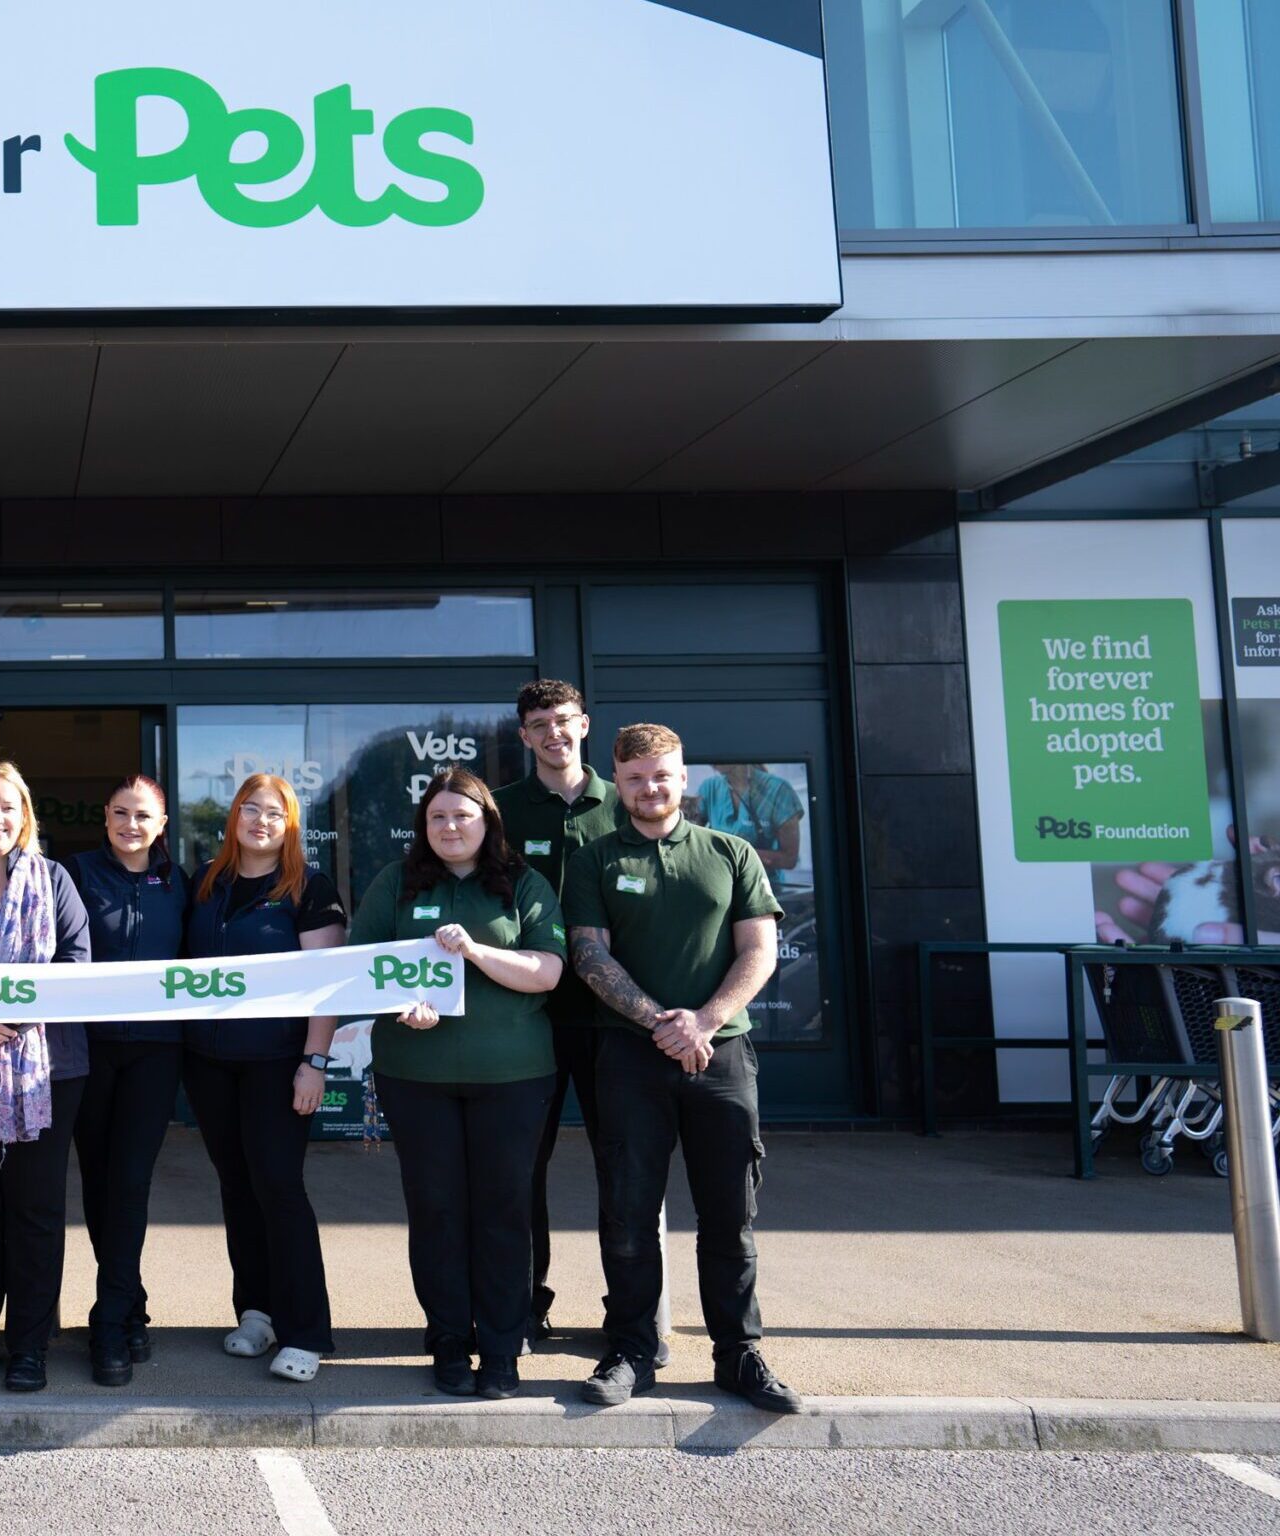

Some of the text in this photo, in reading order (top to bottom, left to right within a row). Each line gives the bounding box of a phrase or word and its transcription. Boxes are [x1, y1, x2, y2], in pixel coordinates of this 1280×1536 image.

[63, 67, 485, 229] Pets
[1243, 619, 1270, 629] Pets
[1256, 631, 1275, 643] for
[1041, 635, 1151, 660] We find
[1046, 666, 1154, 691] forever
[1029, 696, 1175, 722] homes for
[406, 731, 477, 761] Vets
[1046, 727, 1164, 759] adopted
[1073, 761, 1142, 790] pets.
[1036, 816, 1190, 839] Pets Foundation
[160, 966, 247, 999] Pets
[368, 955, 454, 989] Pets
[322, 1090, 348, 1105] ets
